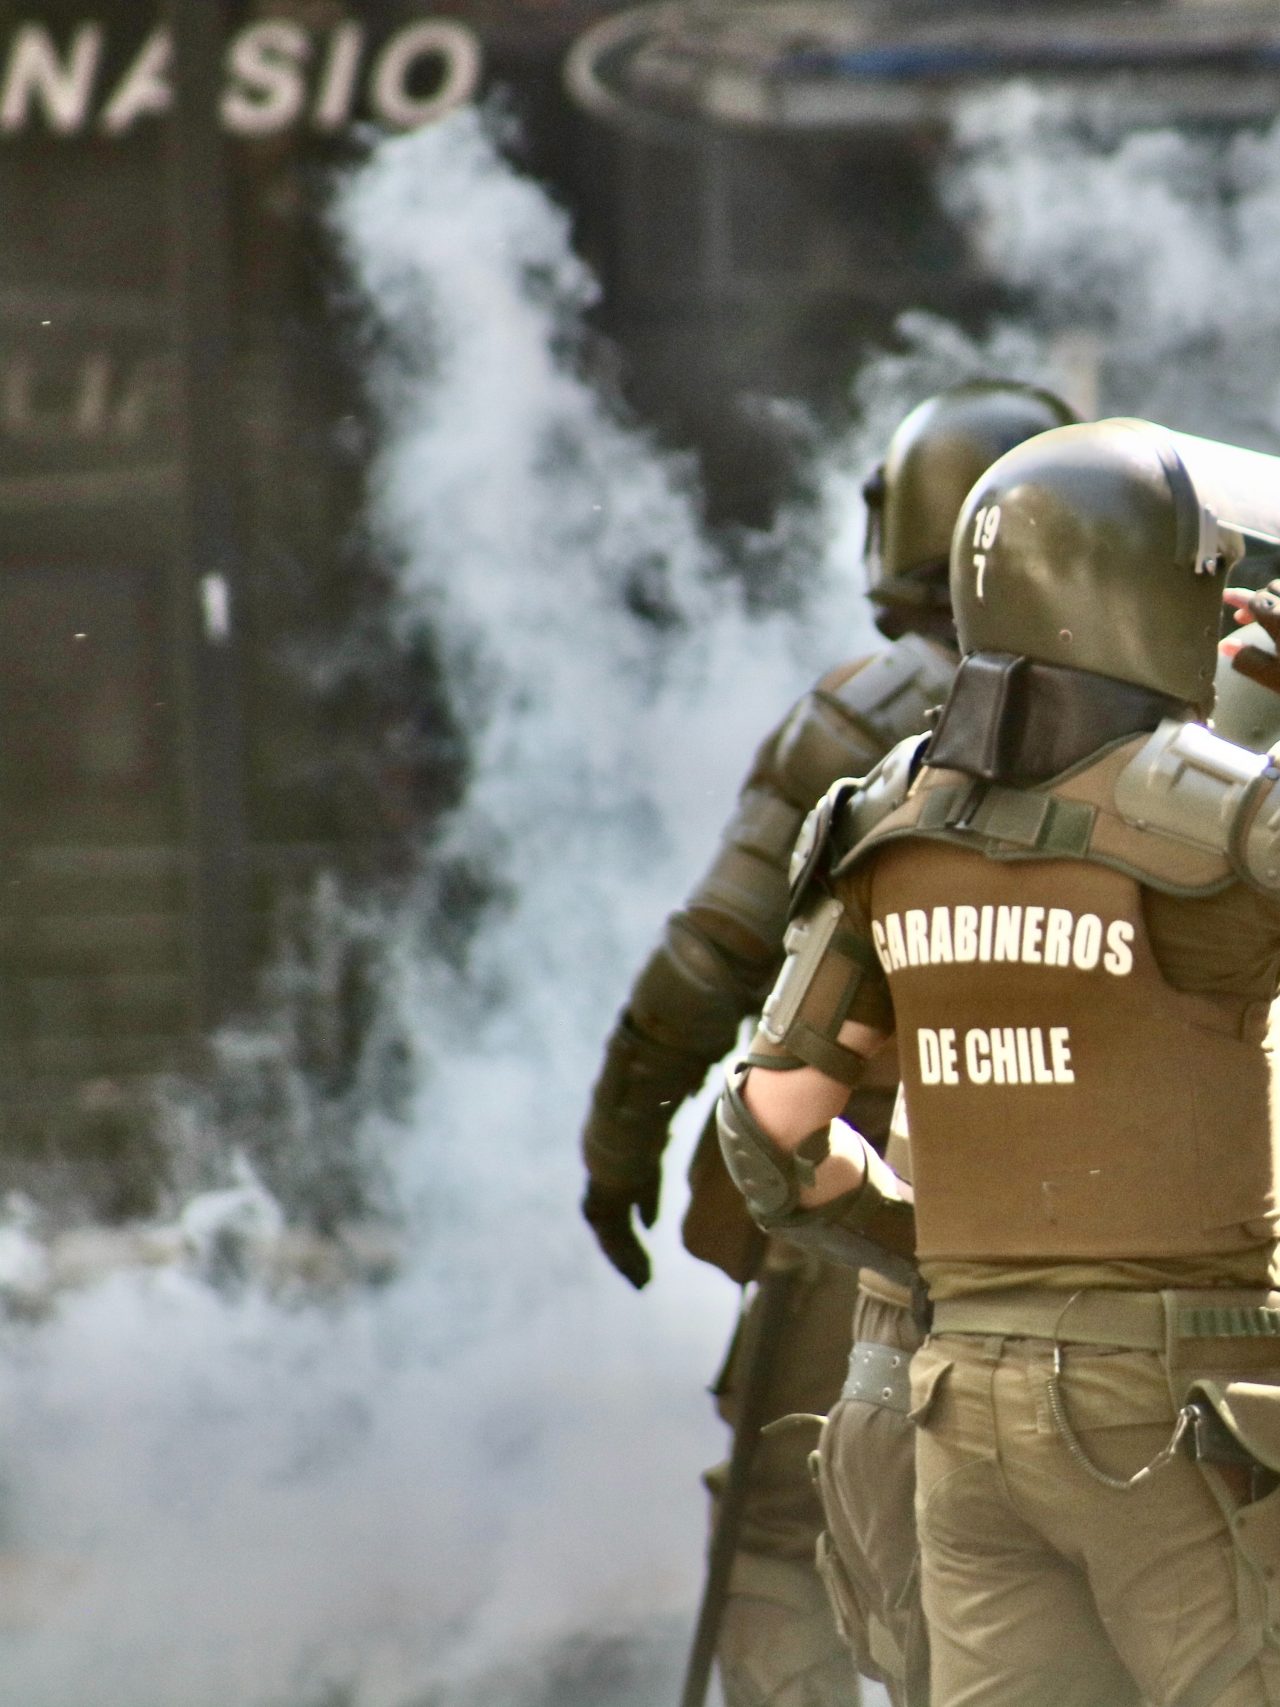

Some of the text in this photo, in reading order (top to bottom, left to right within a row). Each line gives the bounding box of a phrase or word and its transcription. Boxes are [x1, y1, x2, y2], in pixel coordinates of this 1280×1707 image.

[973, 504, 1001, 550] 19
[871, 905, 1135, 976] CARABINEROS
[917, 1026, 1076, 1085] DE CHILE
